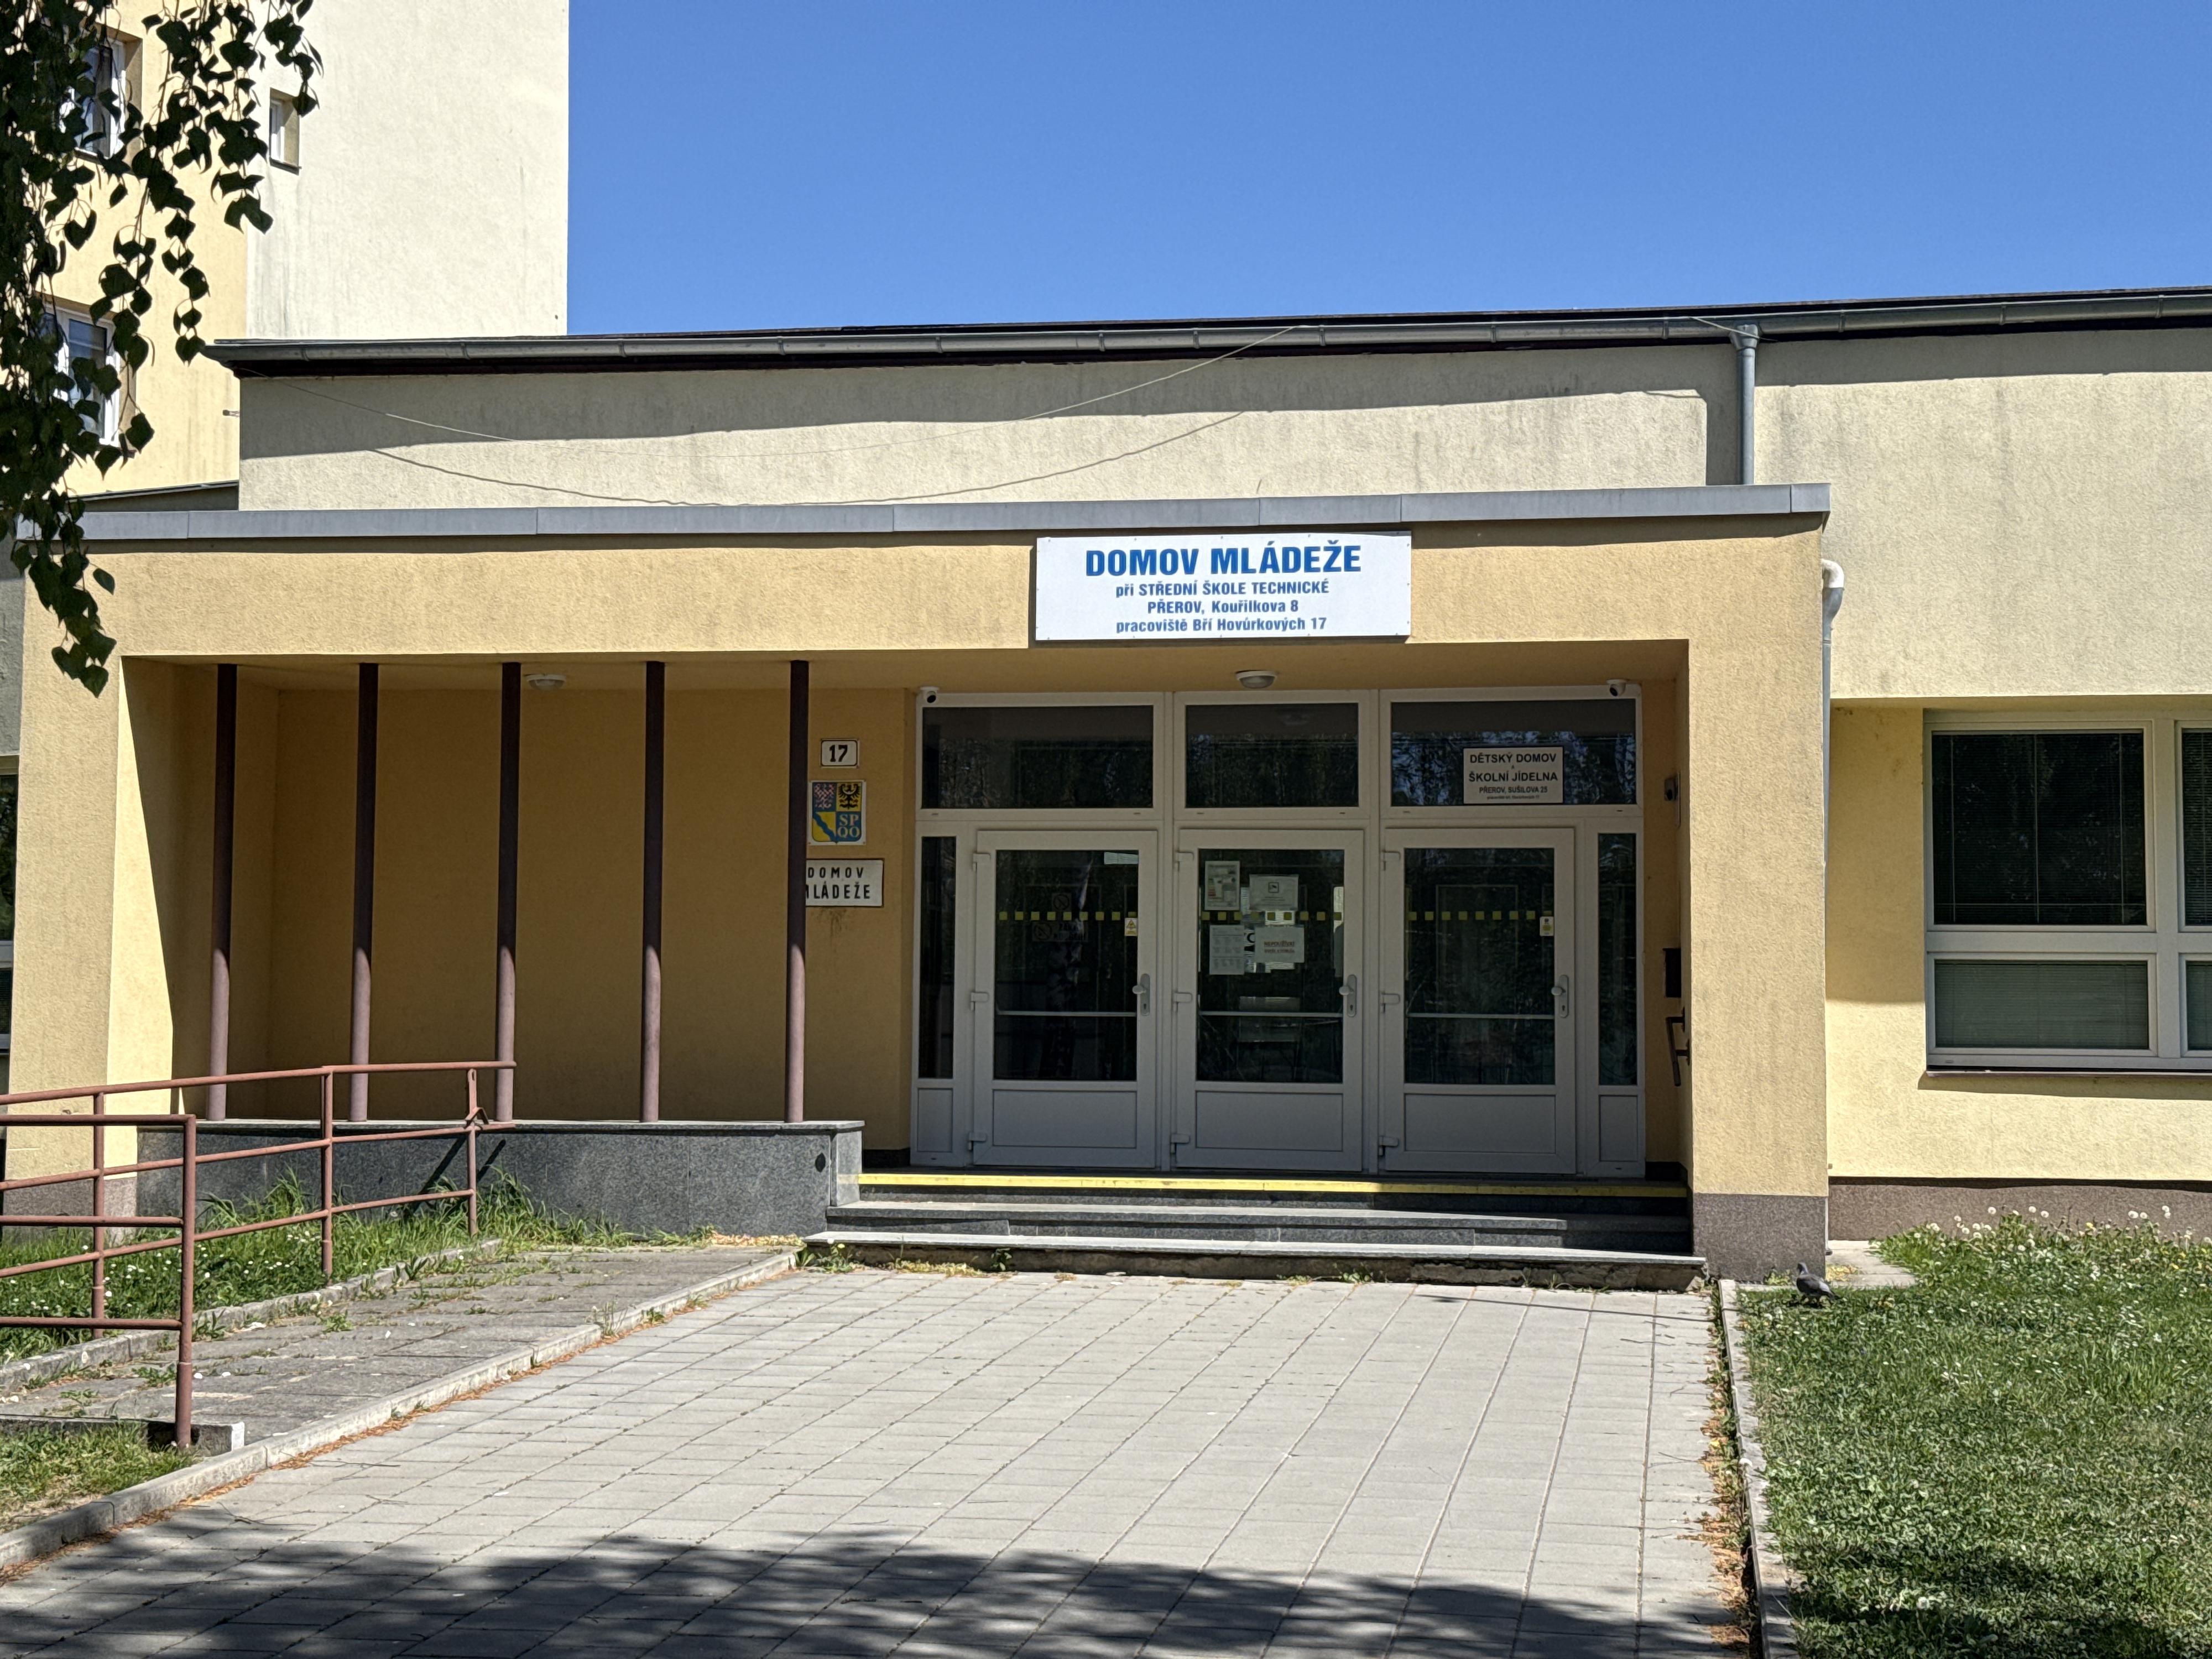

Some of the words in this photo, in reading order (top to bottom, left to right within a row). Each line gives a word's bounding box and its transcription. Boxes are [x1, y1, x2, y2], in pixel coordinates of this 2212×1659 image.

[1086, 549, 1199, 576] DOMOV
[1211, 540, 1361, 574] MLÁDEŽE
[1116, 583, 1134, 598] při
[1139, 580, 1198, 596] STŘEDNÍ
[1202, 580, 1246, 595] ŠKOLE
[1251, 578, 1329, 594] TECHNICKÉ
[1147, 599, 1204, 614] PŘEROV,
[1212, 599, 1286, 613] Kouřilkova
[1290, 599, 1298, 612] 8
[1116, 619, 1187, 633] pracoviště
[1193, 618, 1213, 631] Bří
[1311, 617, 1327, 629] 17
[829, 744, 848, 762] 17
[1470, 752, 1512, 763] DĚTSKÝ
[1516, 753, 1557, 763] DOMOV
[1469, 770, 1509, 782] ŠKOLNÍ
[1512, 770, 1558, 781] JÍDELNA
[839, 814, 859, 826] SP
[837, 826, 860, 838] QO
[808, 867, 864, 878] DOMOV
